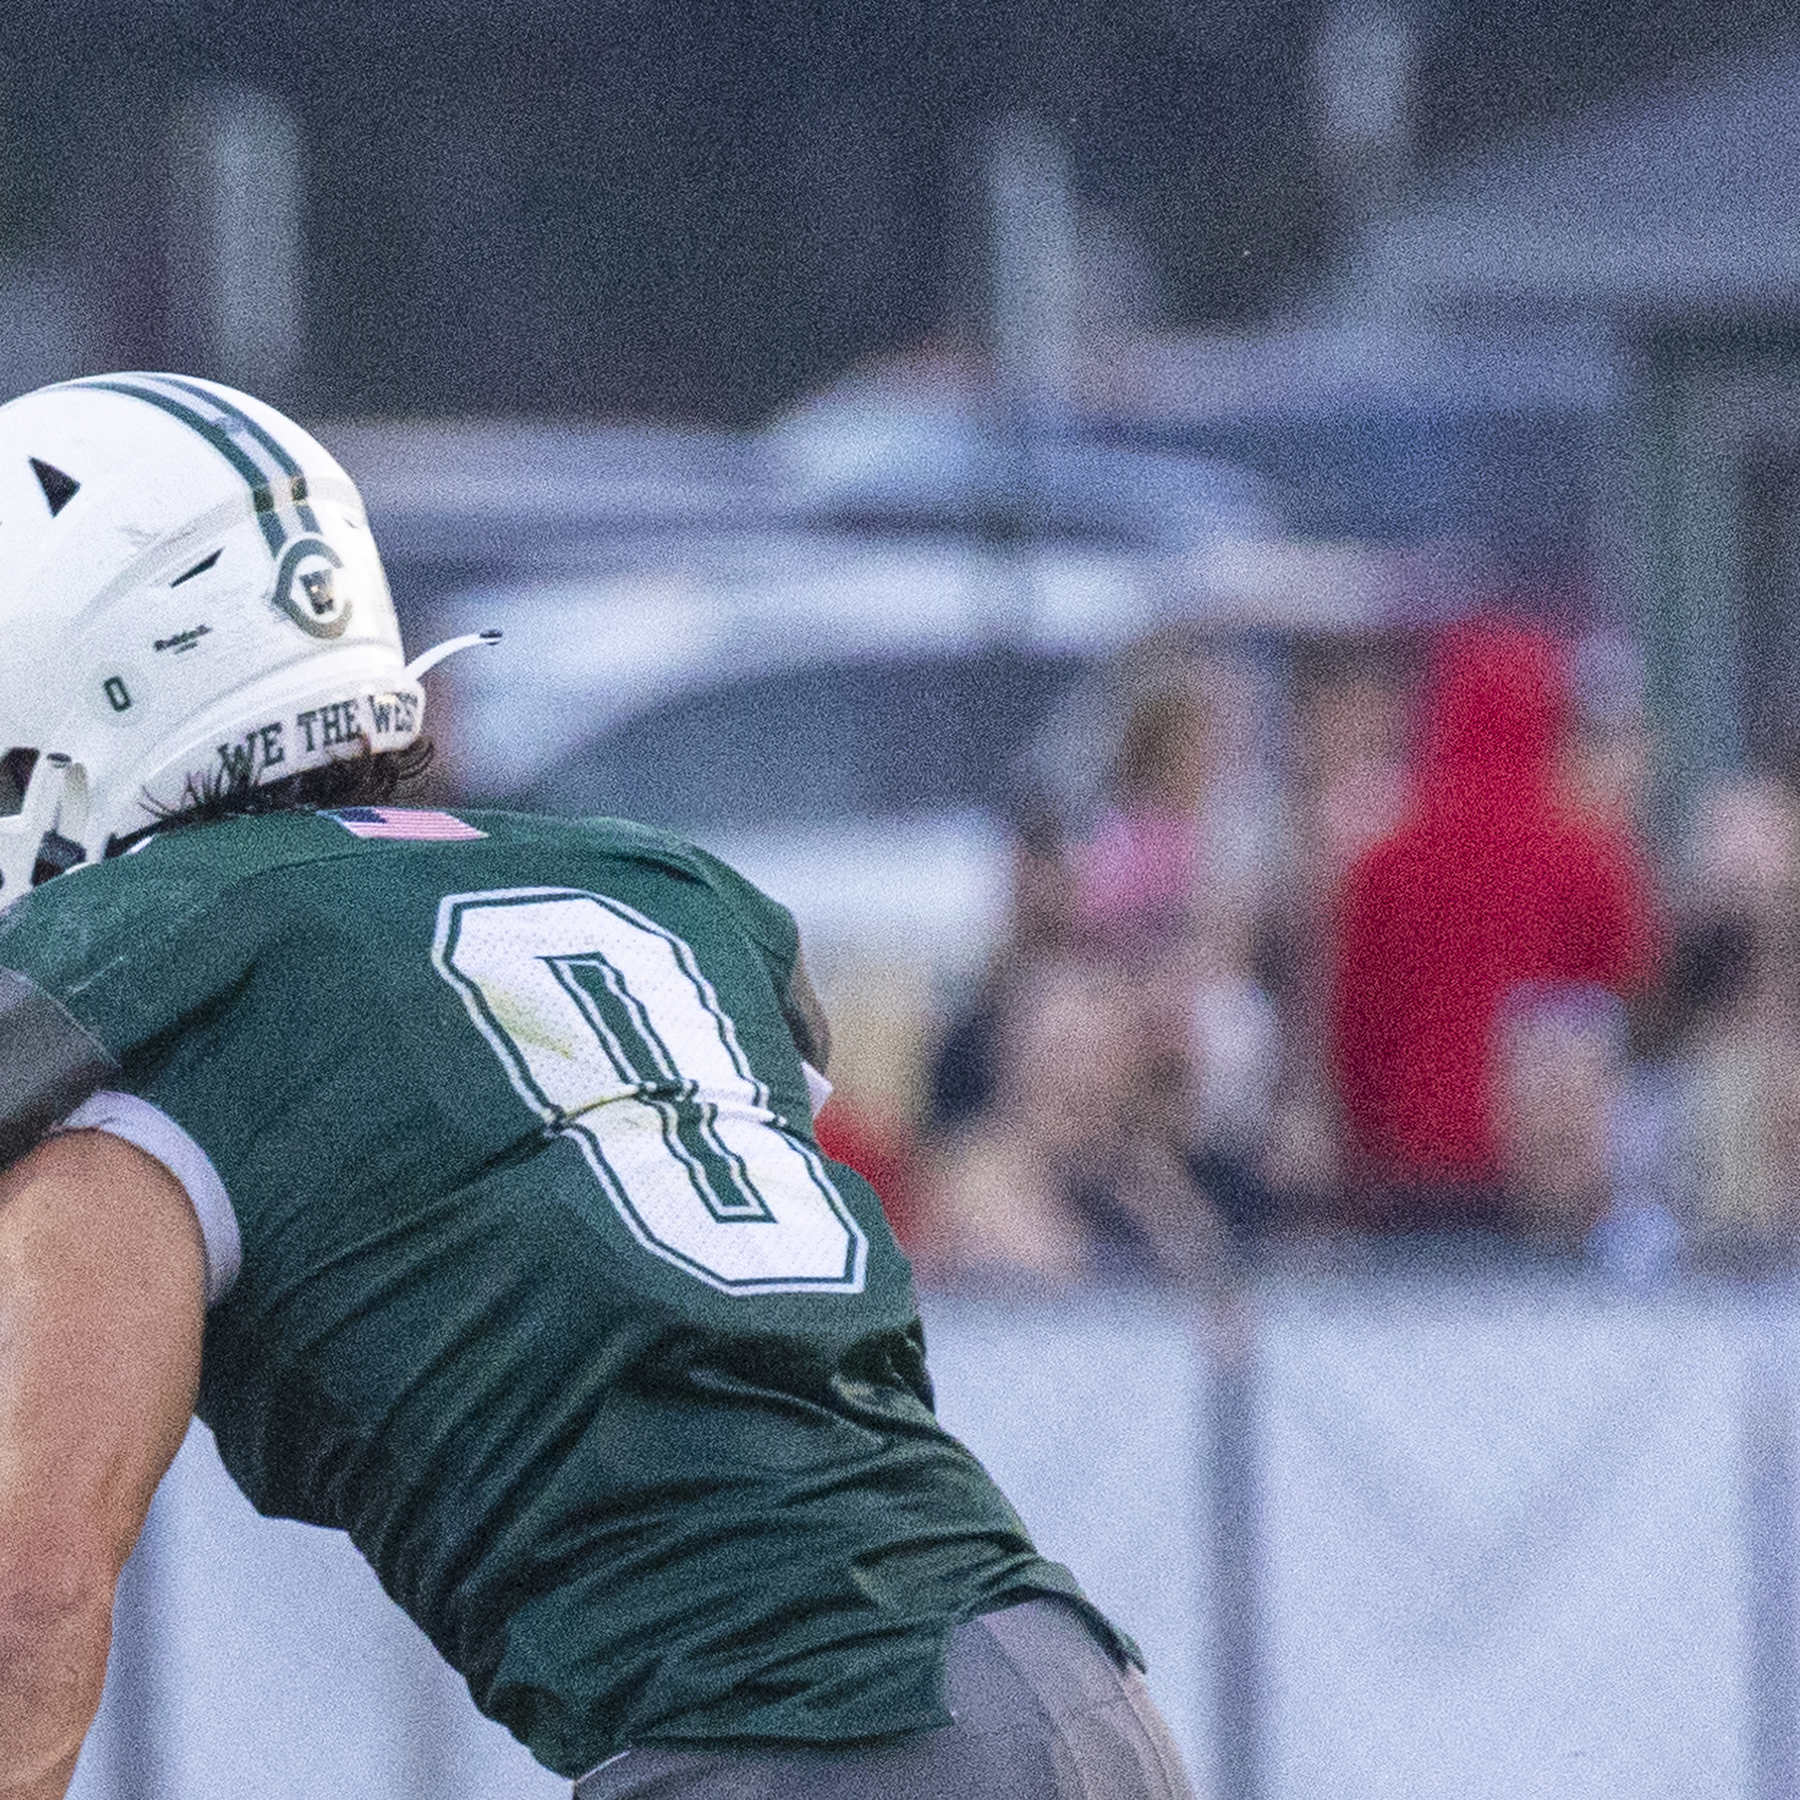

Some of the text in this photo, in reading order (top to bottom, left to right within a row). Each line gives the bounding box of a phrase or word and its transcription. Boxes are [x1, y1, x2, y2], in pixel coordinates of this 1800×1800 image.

[217, 721, 286, 776] WE
[297, 698, 364, 752] THE
[430, 886, 869, 1295] 0
